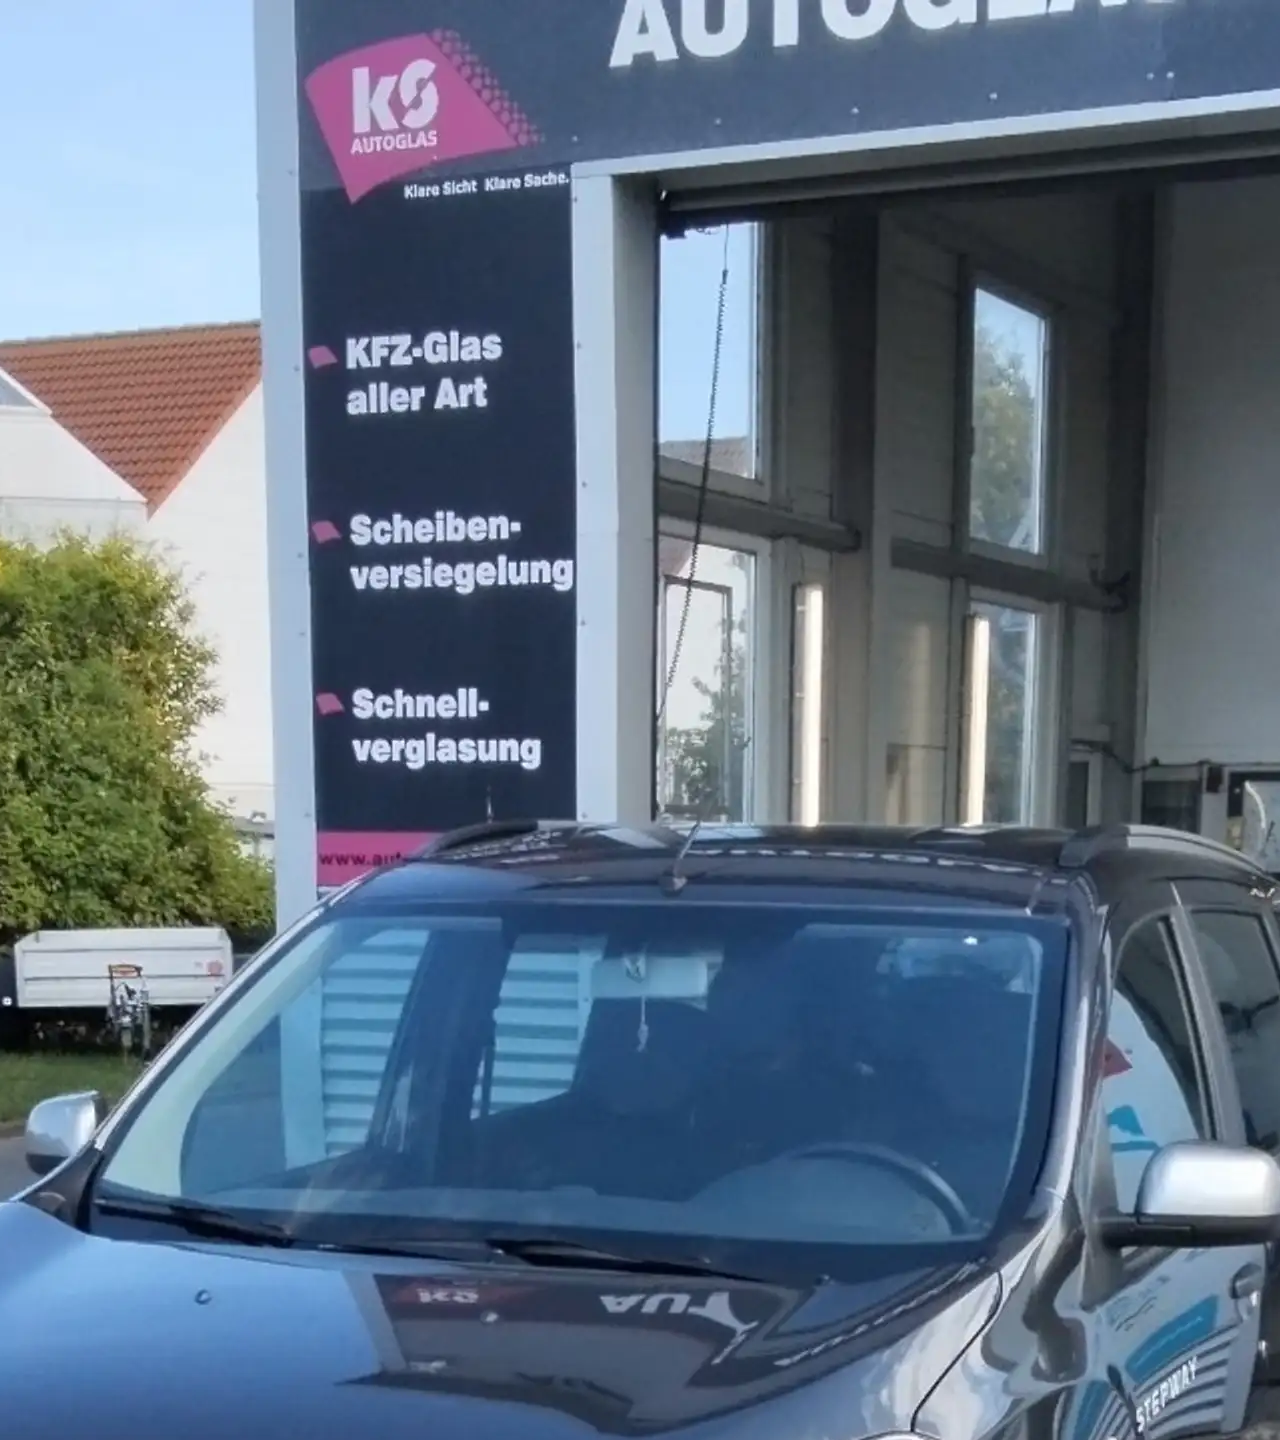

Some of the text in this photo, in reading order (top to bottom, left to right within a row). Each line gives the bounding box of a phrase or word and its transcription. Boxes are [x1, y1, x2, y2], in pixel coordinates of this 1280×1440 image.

[608, 0, 1130, 67] AUTO
[351, 130, 438, 155] AUTOGLAS
[403, 183, 440, 199] Klare
[484, 175, 521, 191] Klare
[524, 170, 570, 188] Sache.
[345, 330, 503, 369] KFZ-Glas
[346, 376, 488, 415] aller Art
[349, 510, 521, 546] Scheiben-
[349, 554, 573, 595] versiegelung
[352, 687, 490, 720] Schnell-
[352, 732, 542, 770] verglasung
[1135, 1355, 1199, 1433] STEPWAY
